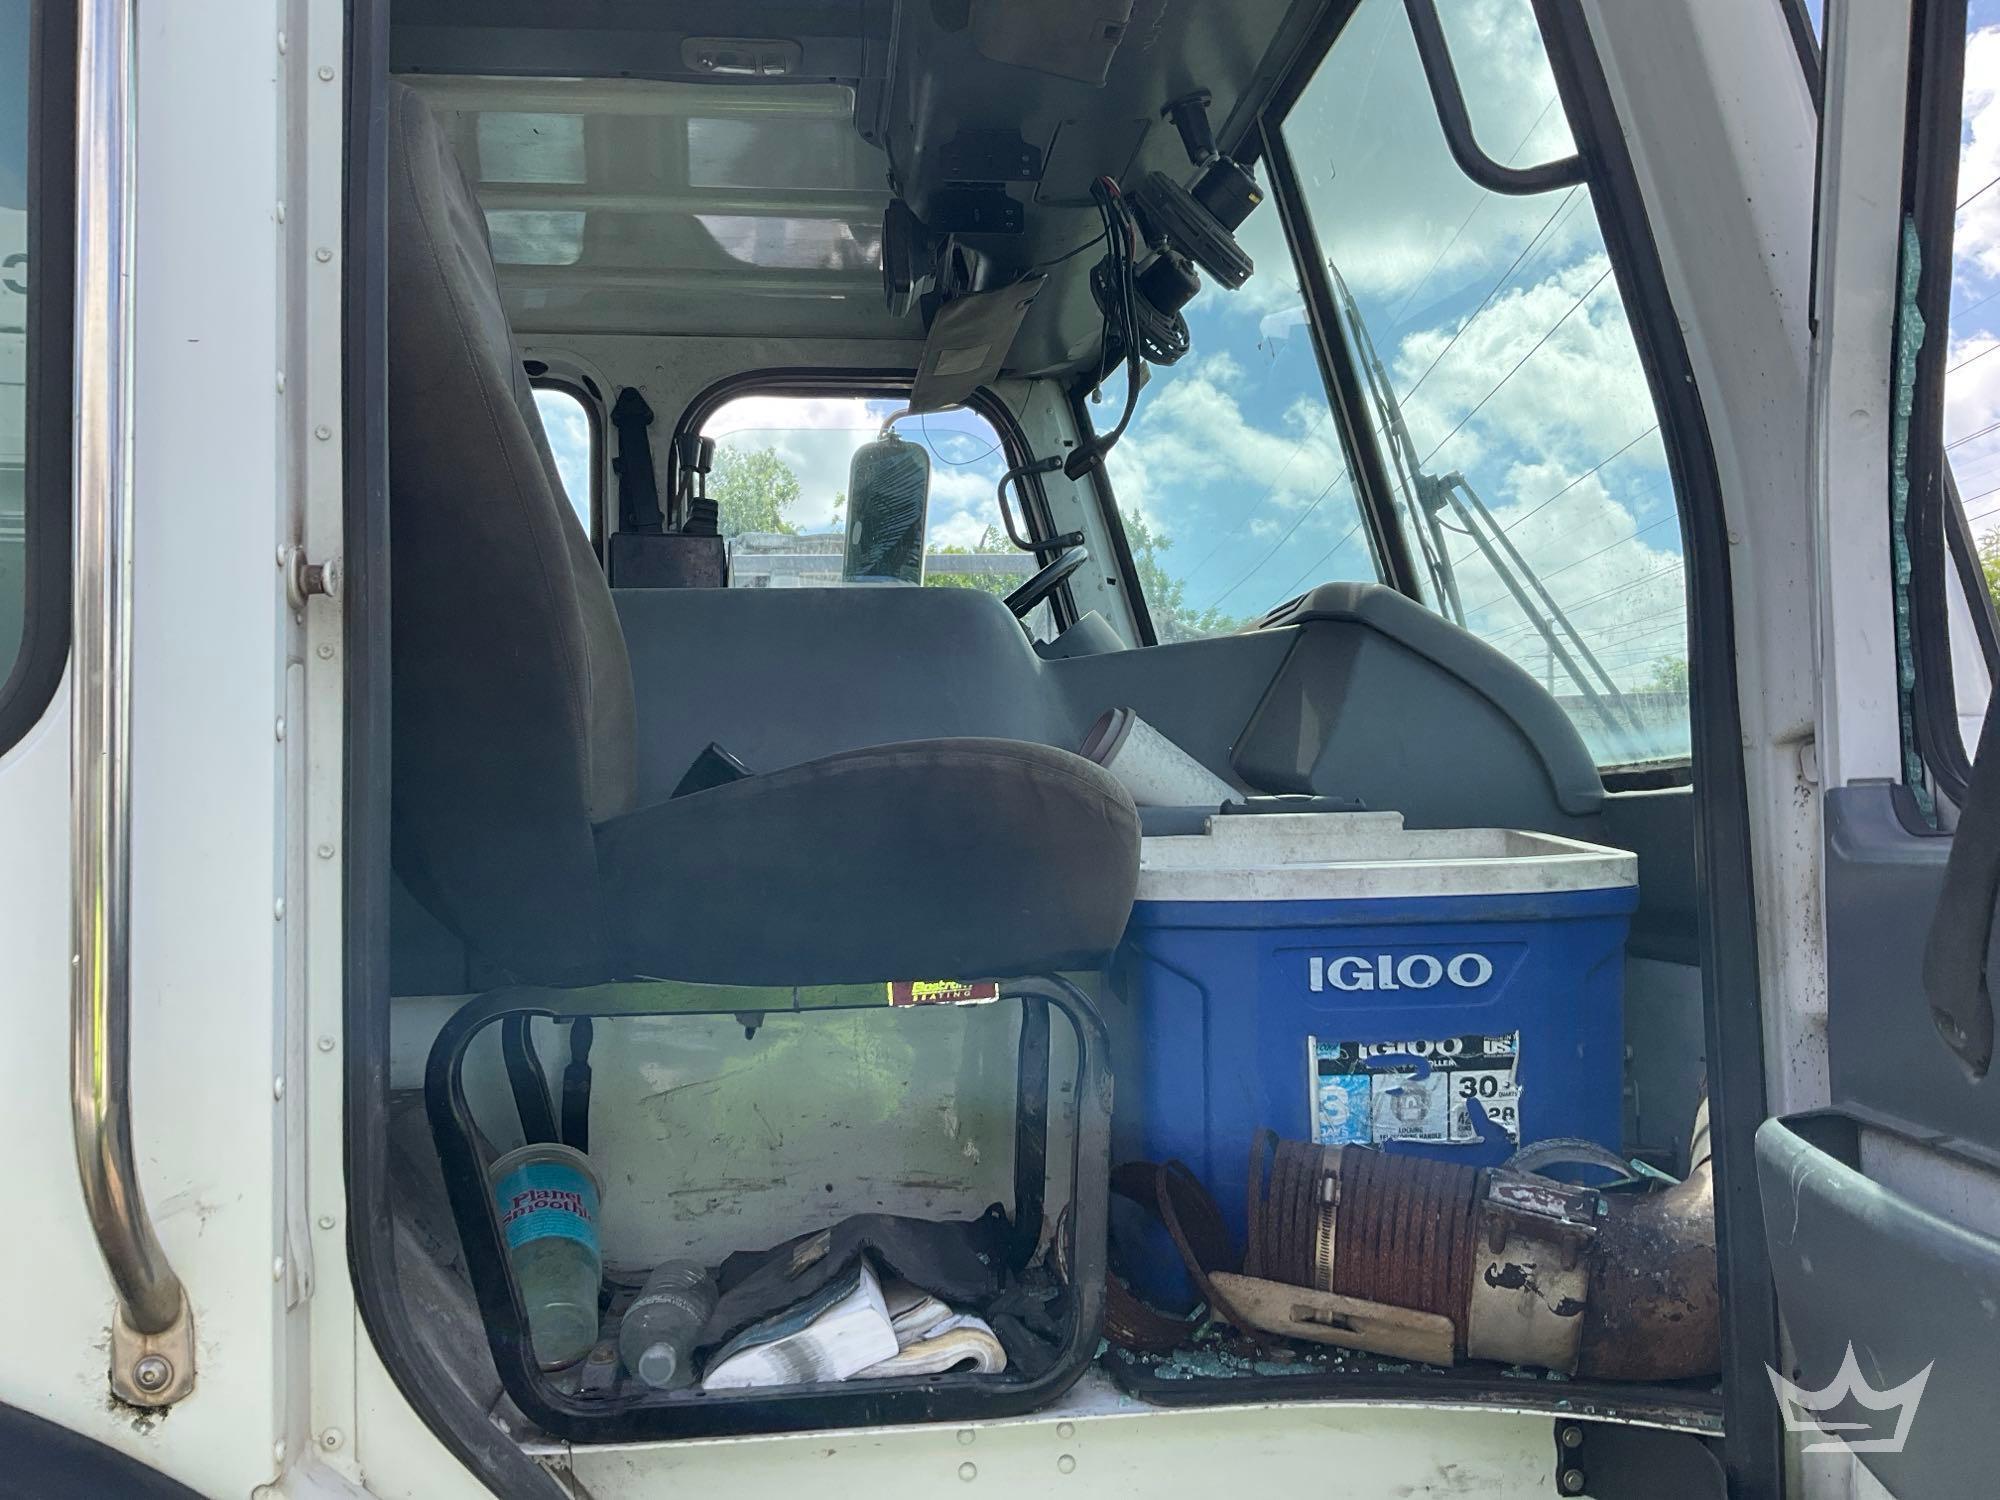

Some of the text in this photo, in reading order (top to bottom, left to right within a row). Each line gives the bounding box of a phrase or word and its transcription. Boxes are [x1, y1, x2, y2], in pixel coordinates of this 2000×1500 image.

[1309, 953, 1493, 992] IGLOO
[912, 991, 971, 1001] SEATING
[1483, 1040, 1514, 1055] US
[1459, 1075, 1498, 1098] 30
[511, 1188, 583, 1209] Planet
